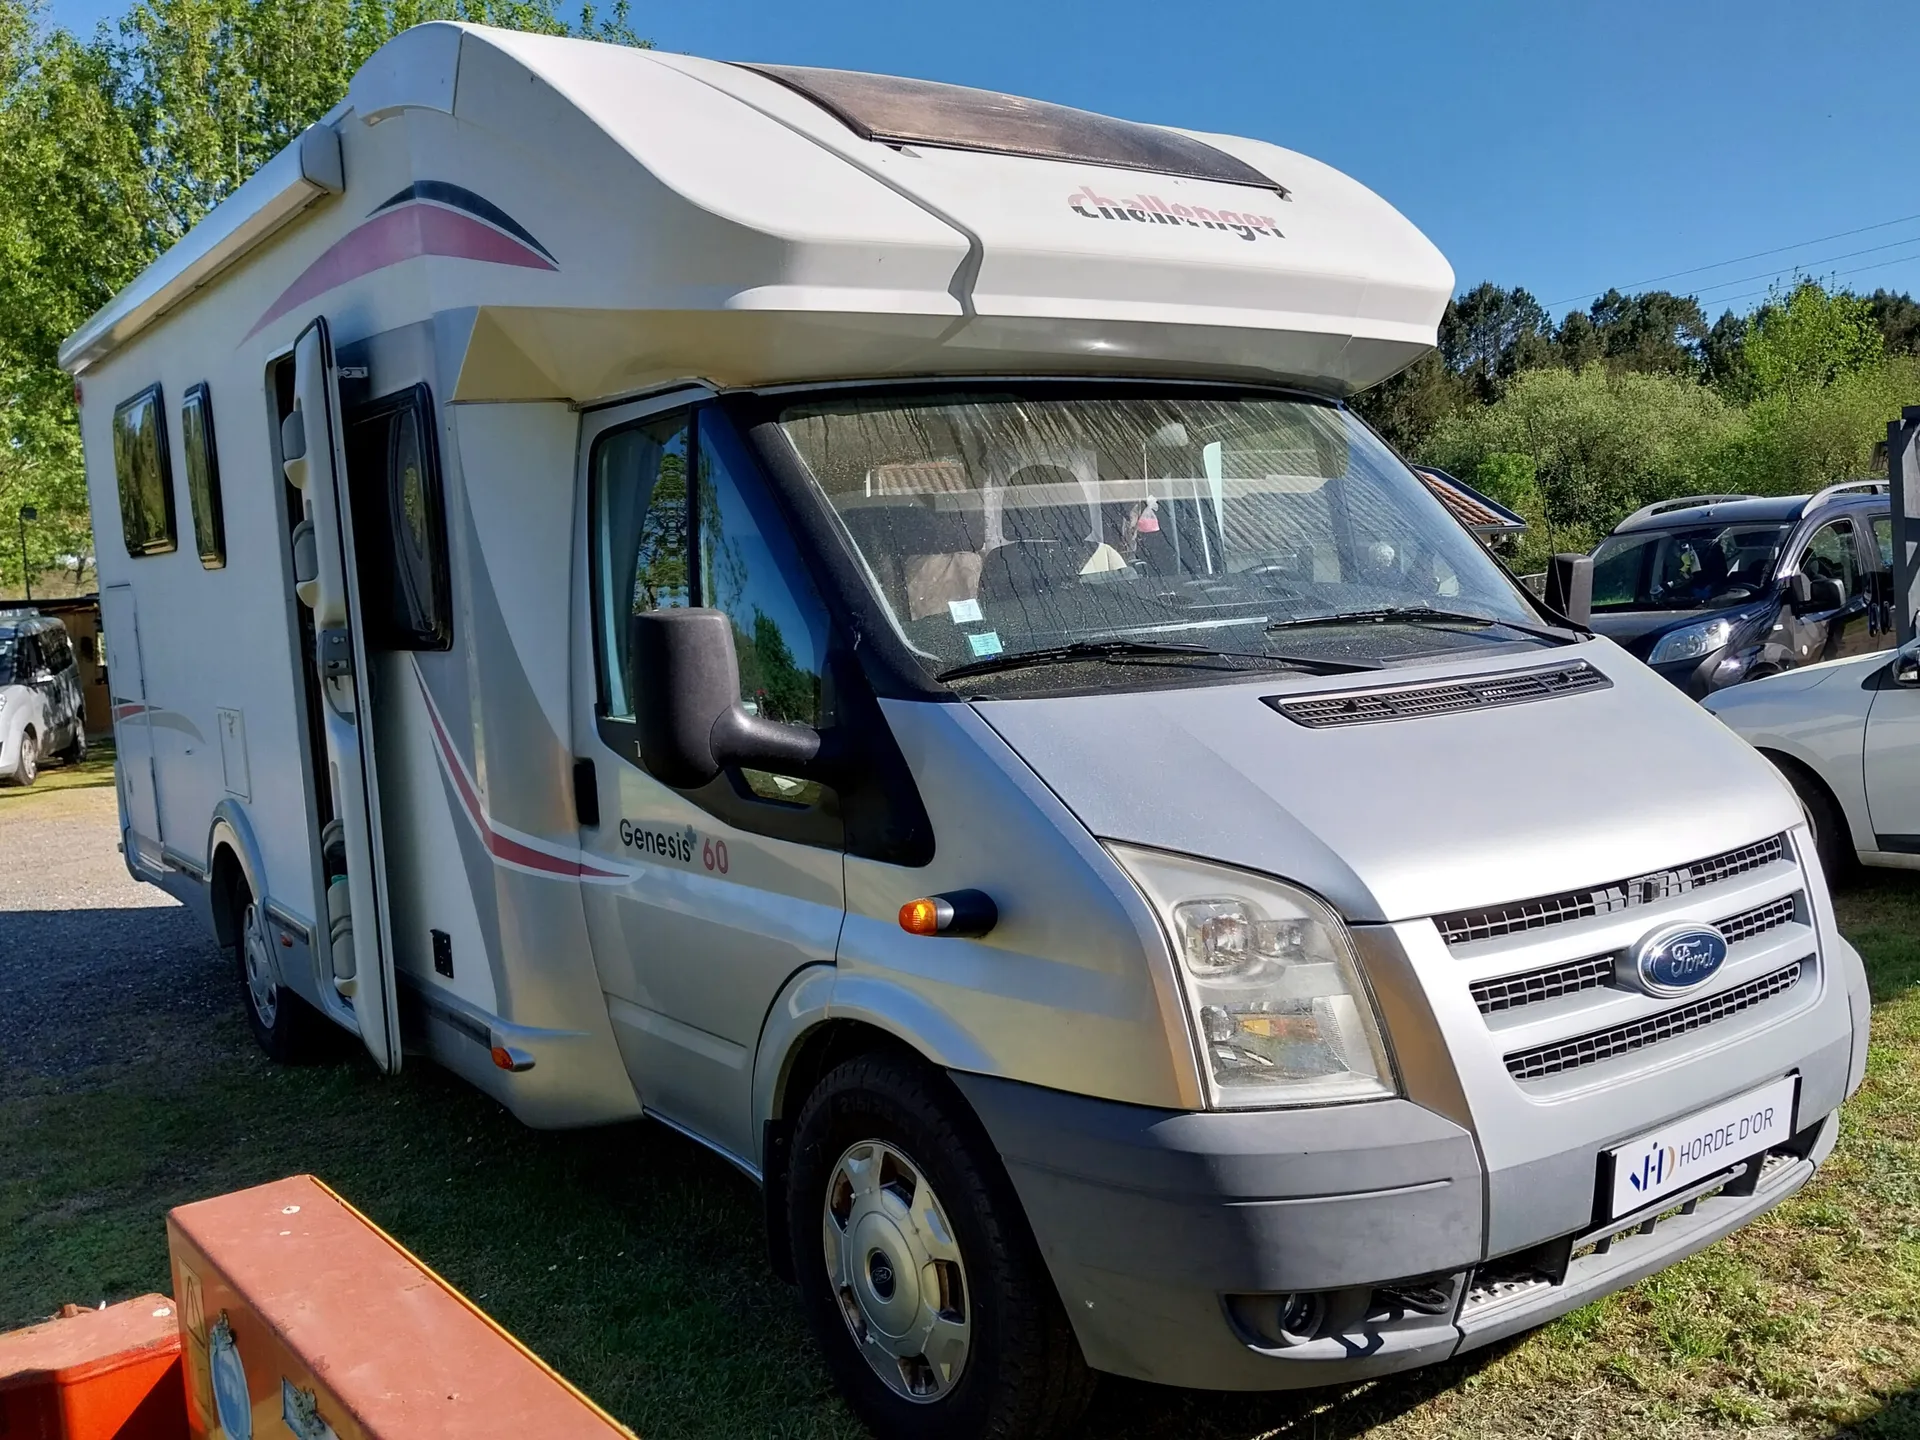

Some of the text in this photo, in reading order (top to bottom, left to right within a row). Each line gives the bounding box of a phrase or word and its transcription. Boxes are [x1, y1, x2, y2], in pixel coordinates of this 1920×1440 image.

[1067, 185, 1286, 242] challenger
[619, 818, 729, 874] Genesis 60
[1670, 939, 1715, 978] Ford
[1679, 1122, 1736, 1168] HORDE
[1738, 1107, 1774, 1141] D'OR
